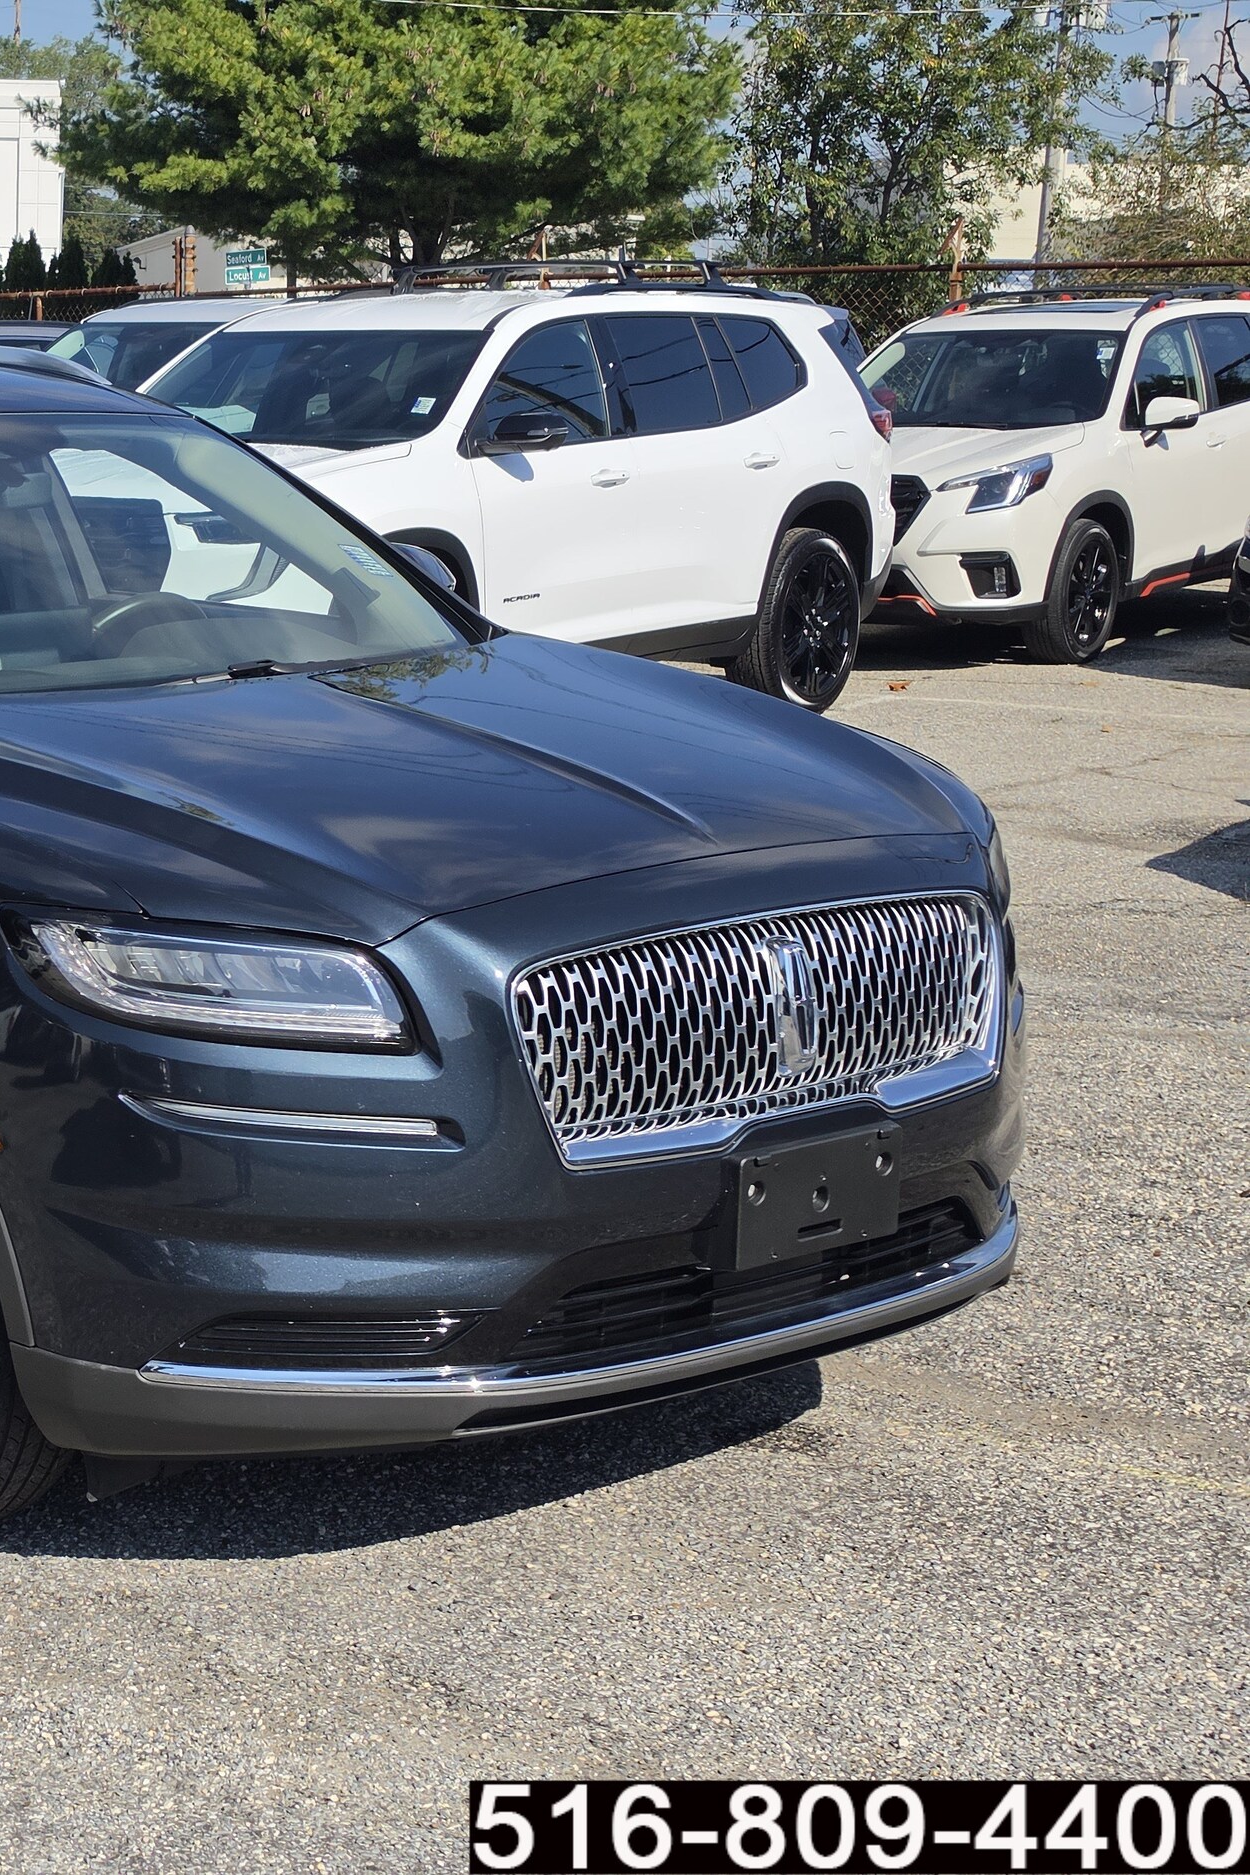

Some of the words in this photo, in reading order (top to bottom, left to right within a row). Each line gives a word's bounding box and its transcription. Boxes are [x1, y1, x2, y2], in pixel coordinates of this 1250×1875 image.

[227, 253, 253, 265] Seaford
[229, 270, 253, 281] Locust
[503, 593, 540, 603] ACADIA
